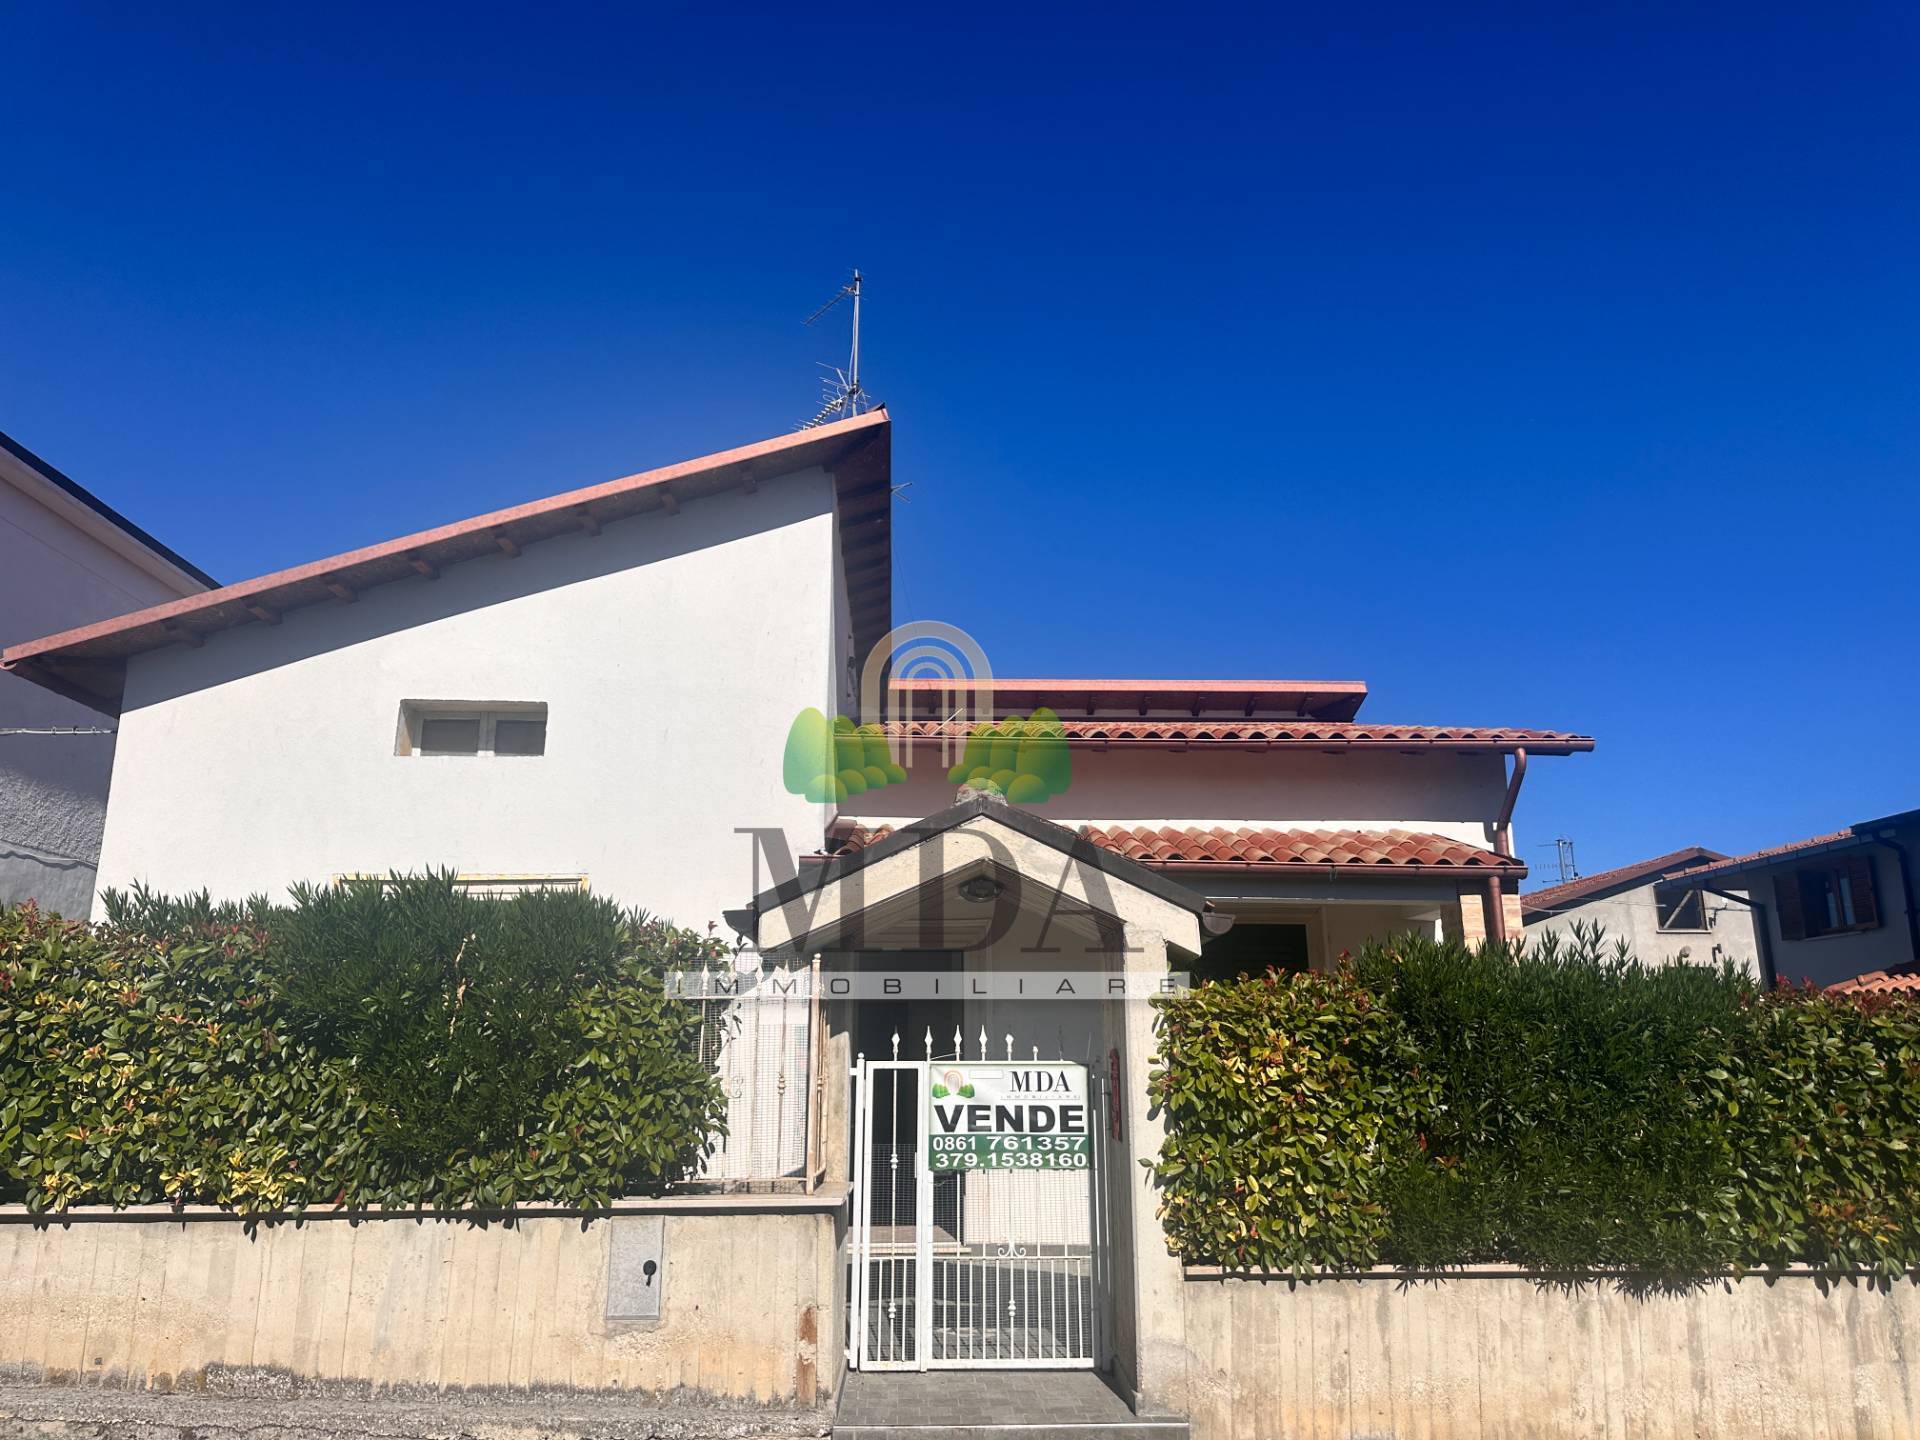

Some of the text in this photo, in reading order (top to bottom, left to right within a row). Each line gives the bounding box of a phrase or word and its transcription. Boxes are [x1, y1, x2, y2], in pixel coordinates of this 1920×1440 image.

[1009, 1070, 1072, 1092] MDA
[934, 1104, 1085, 1133] VENDE
[932, 1135, 1086, 1151] 0861 761357
